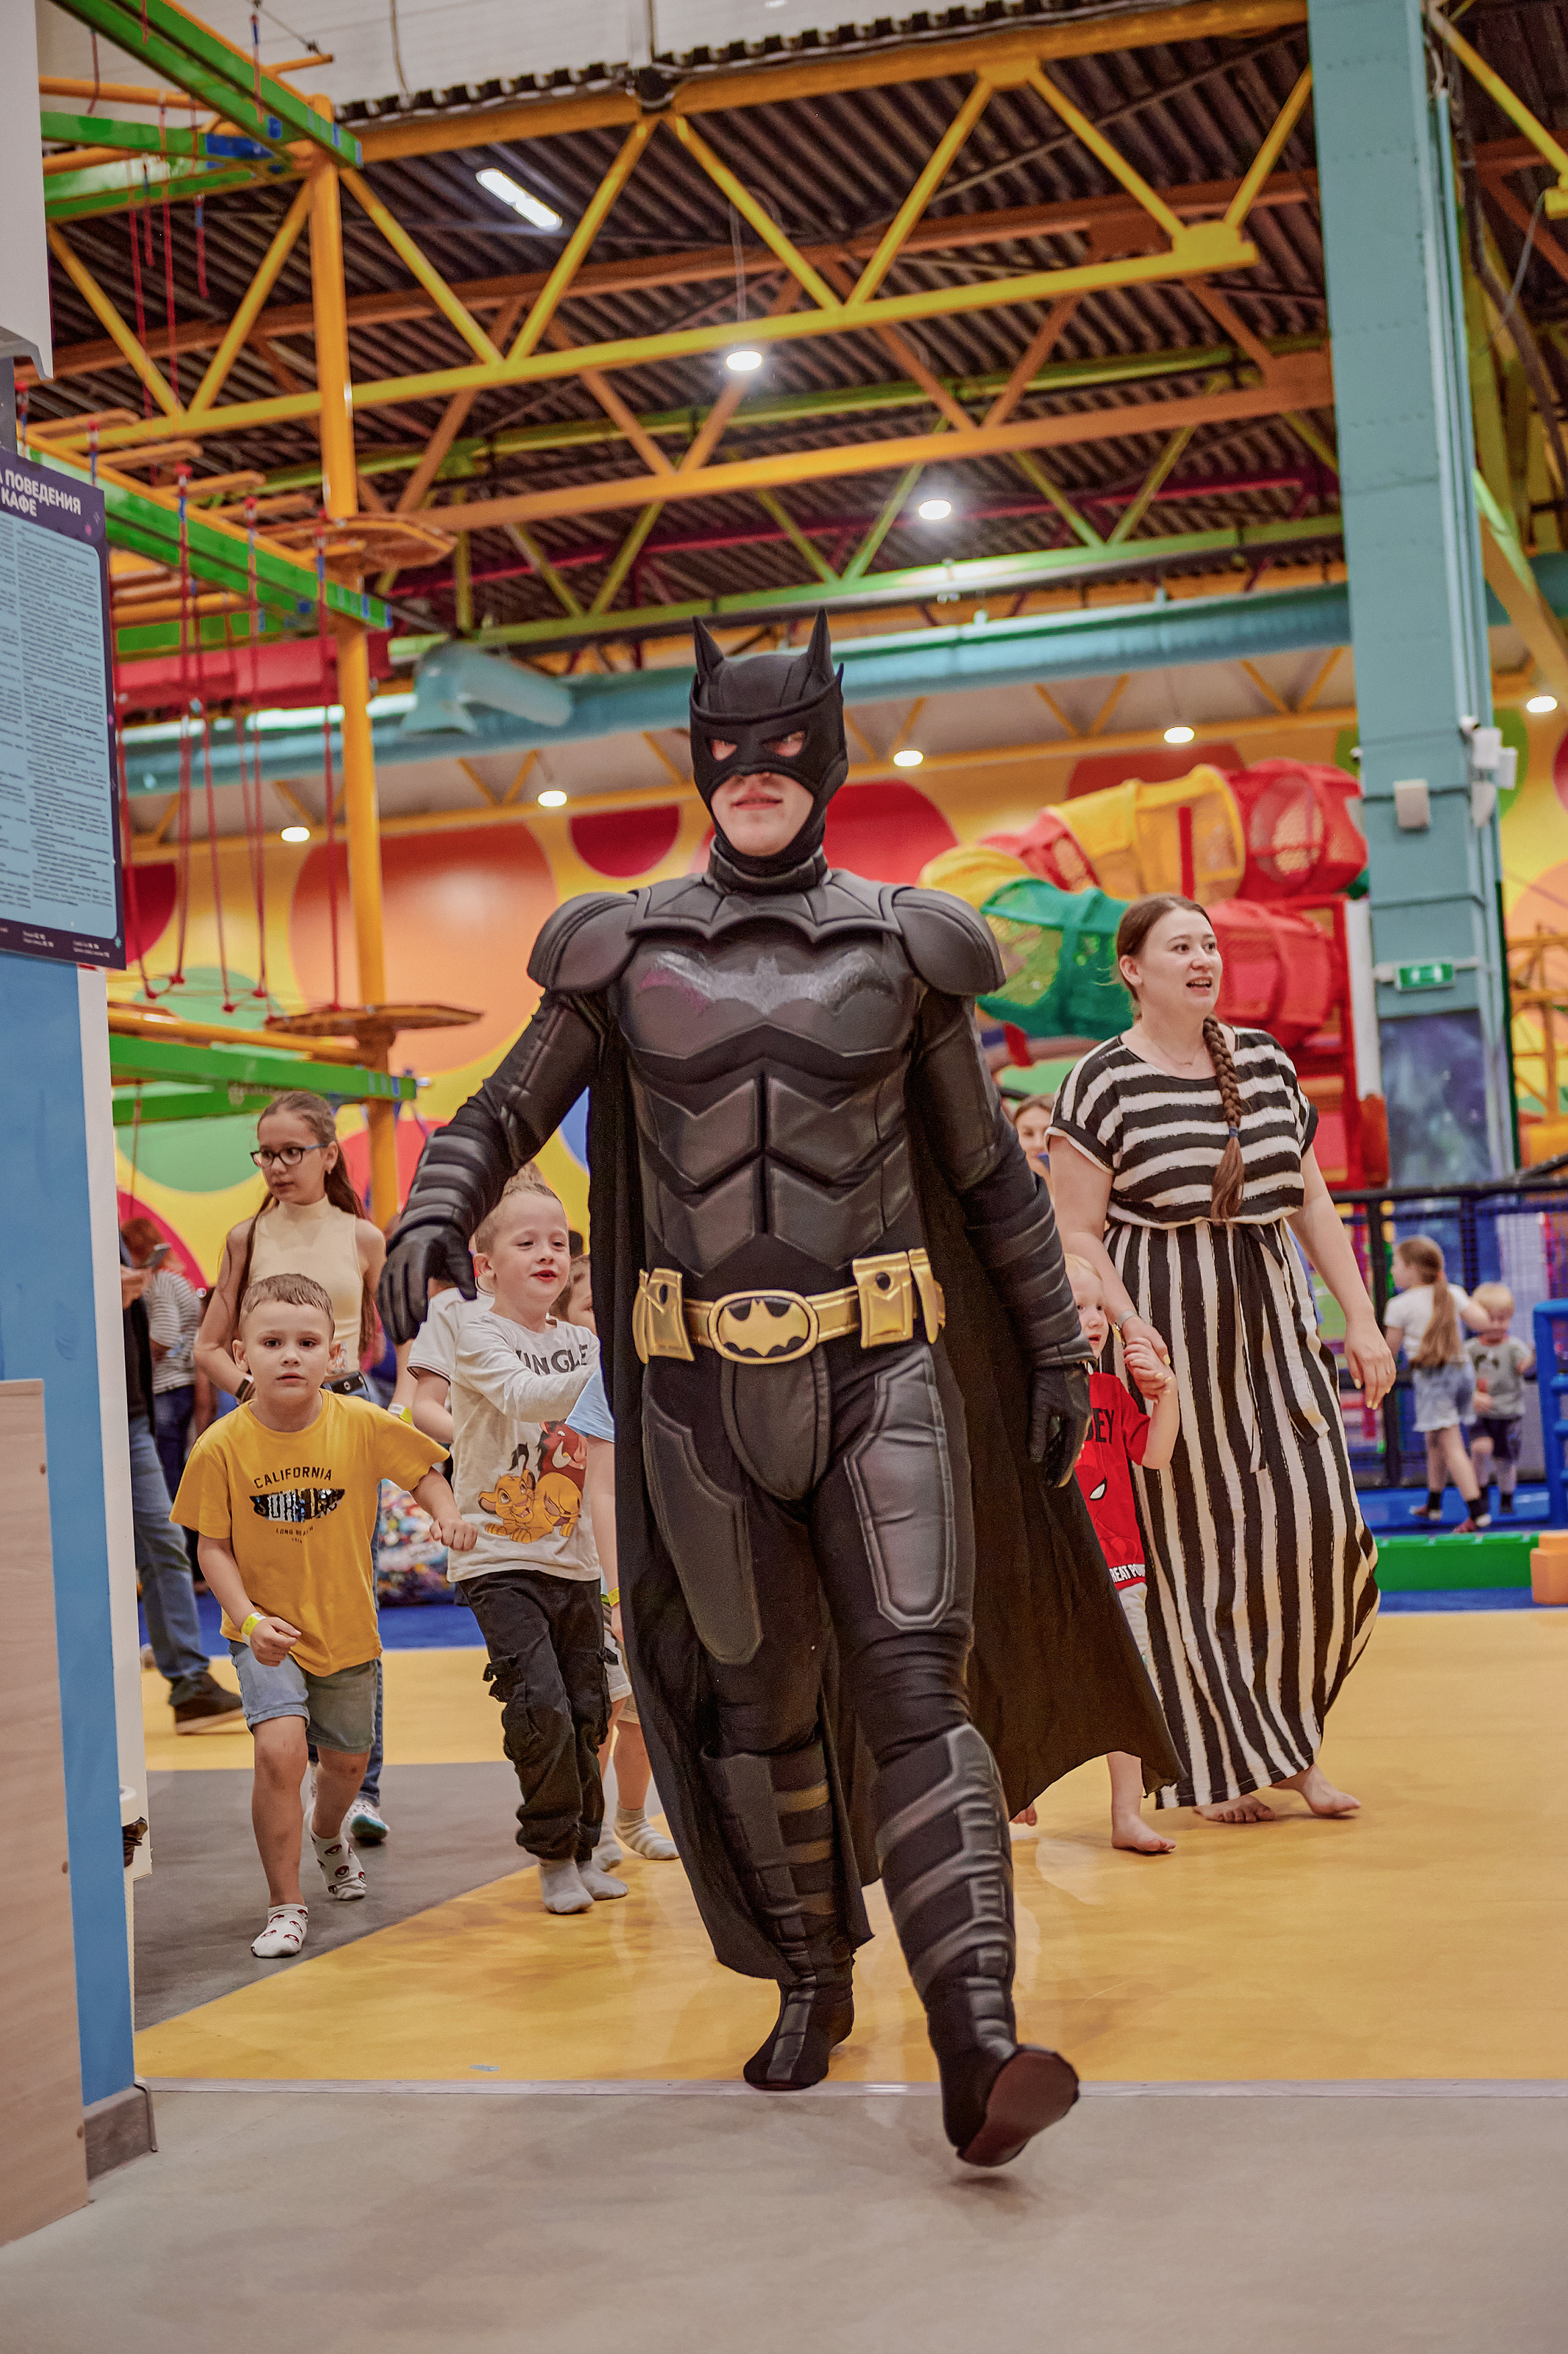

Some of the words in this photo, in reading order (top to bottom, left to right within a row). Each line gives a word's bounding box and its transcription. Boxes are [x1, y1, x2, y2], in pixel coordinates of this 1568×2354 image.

[1, 486, 37, 517] КАФЕ
[5, 469, 81, 515] ПОВЕДЕНИЯ
[254, 1466, 332, 1488] CALIFORNIA
